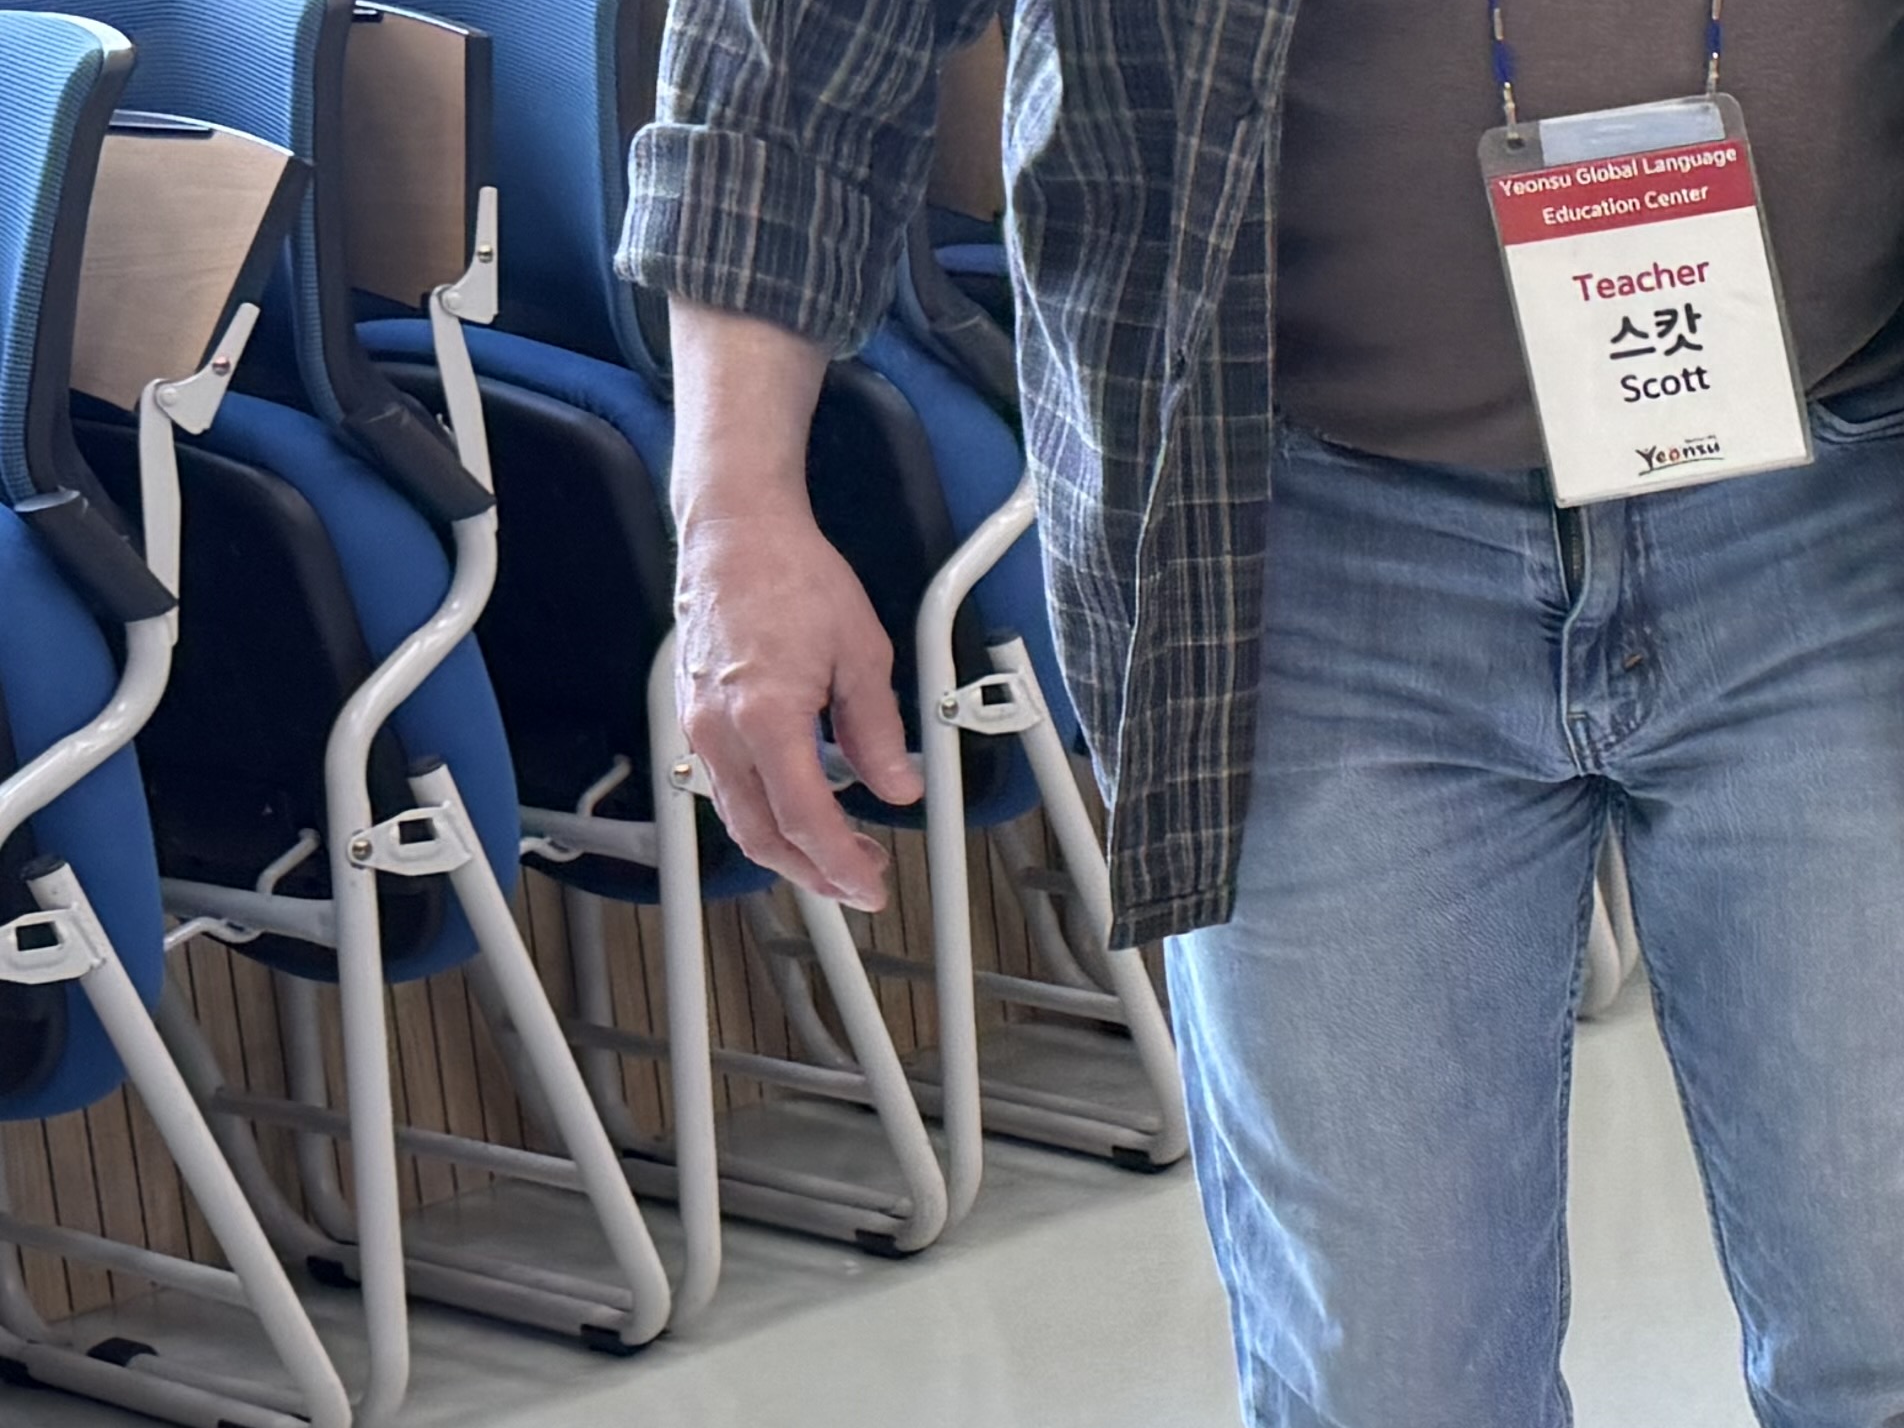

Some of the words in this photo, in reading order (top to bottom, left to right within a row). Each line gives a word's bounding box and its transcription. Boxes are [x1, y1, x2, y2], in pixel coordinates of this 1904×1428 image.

[1499, 174, 1572, 197] Yeonsu
[1575, 158, 1639, 186] Global
[1641, 146, 1738, 175] Language
[1542, 196, 1641, 225] Education
[1644, 184, 1709, 209] Center
[1571, 261, 1710, 302] Teacher
[1609, 302, 1703, 360] 스캇
[1620, 365, 1711, 403] Scott
